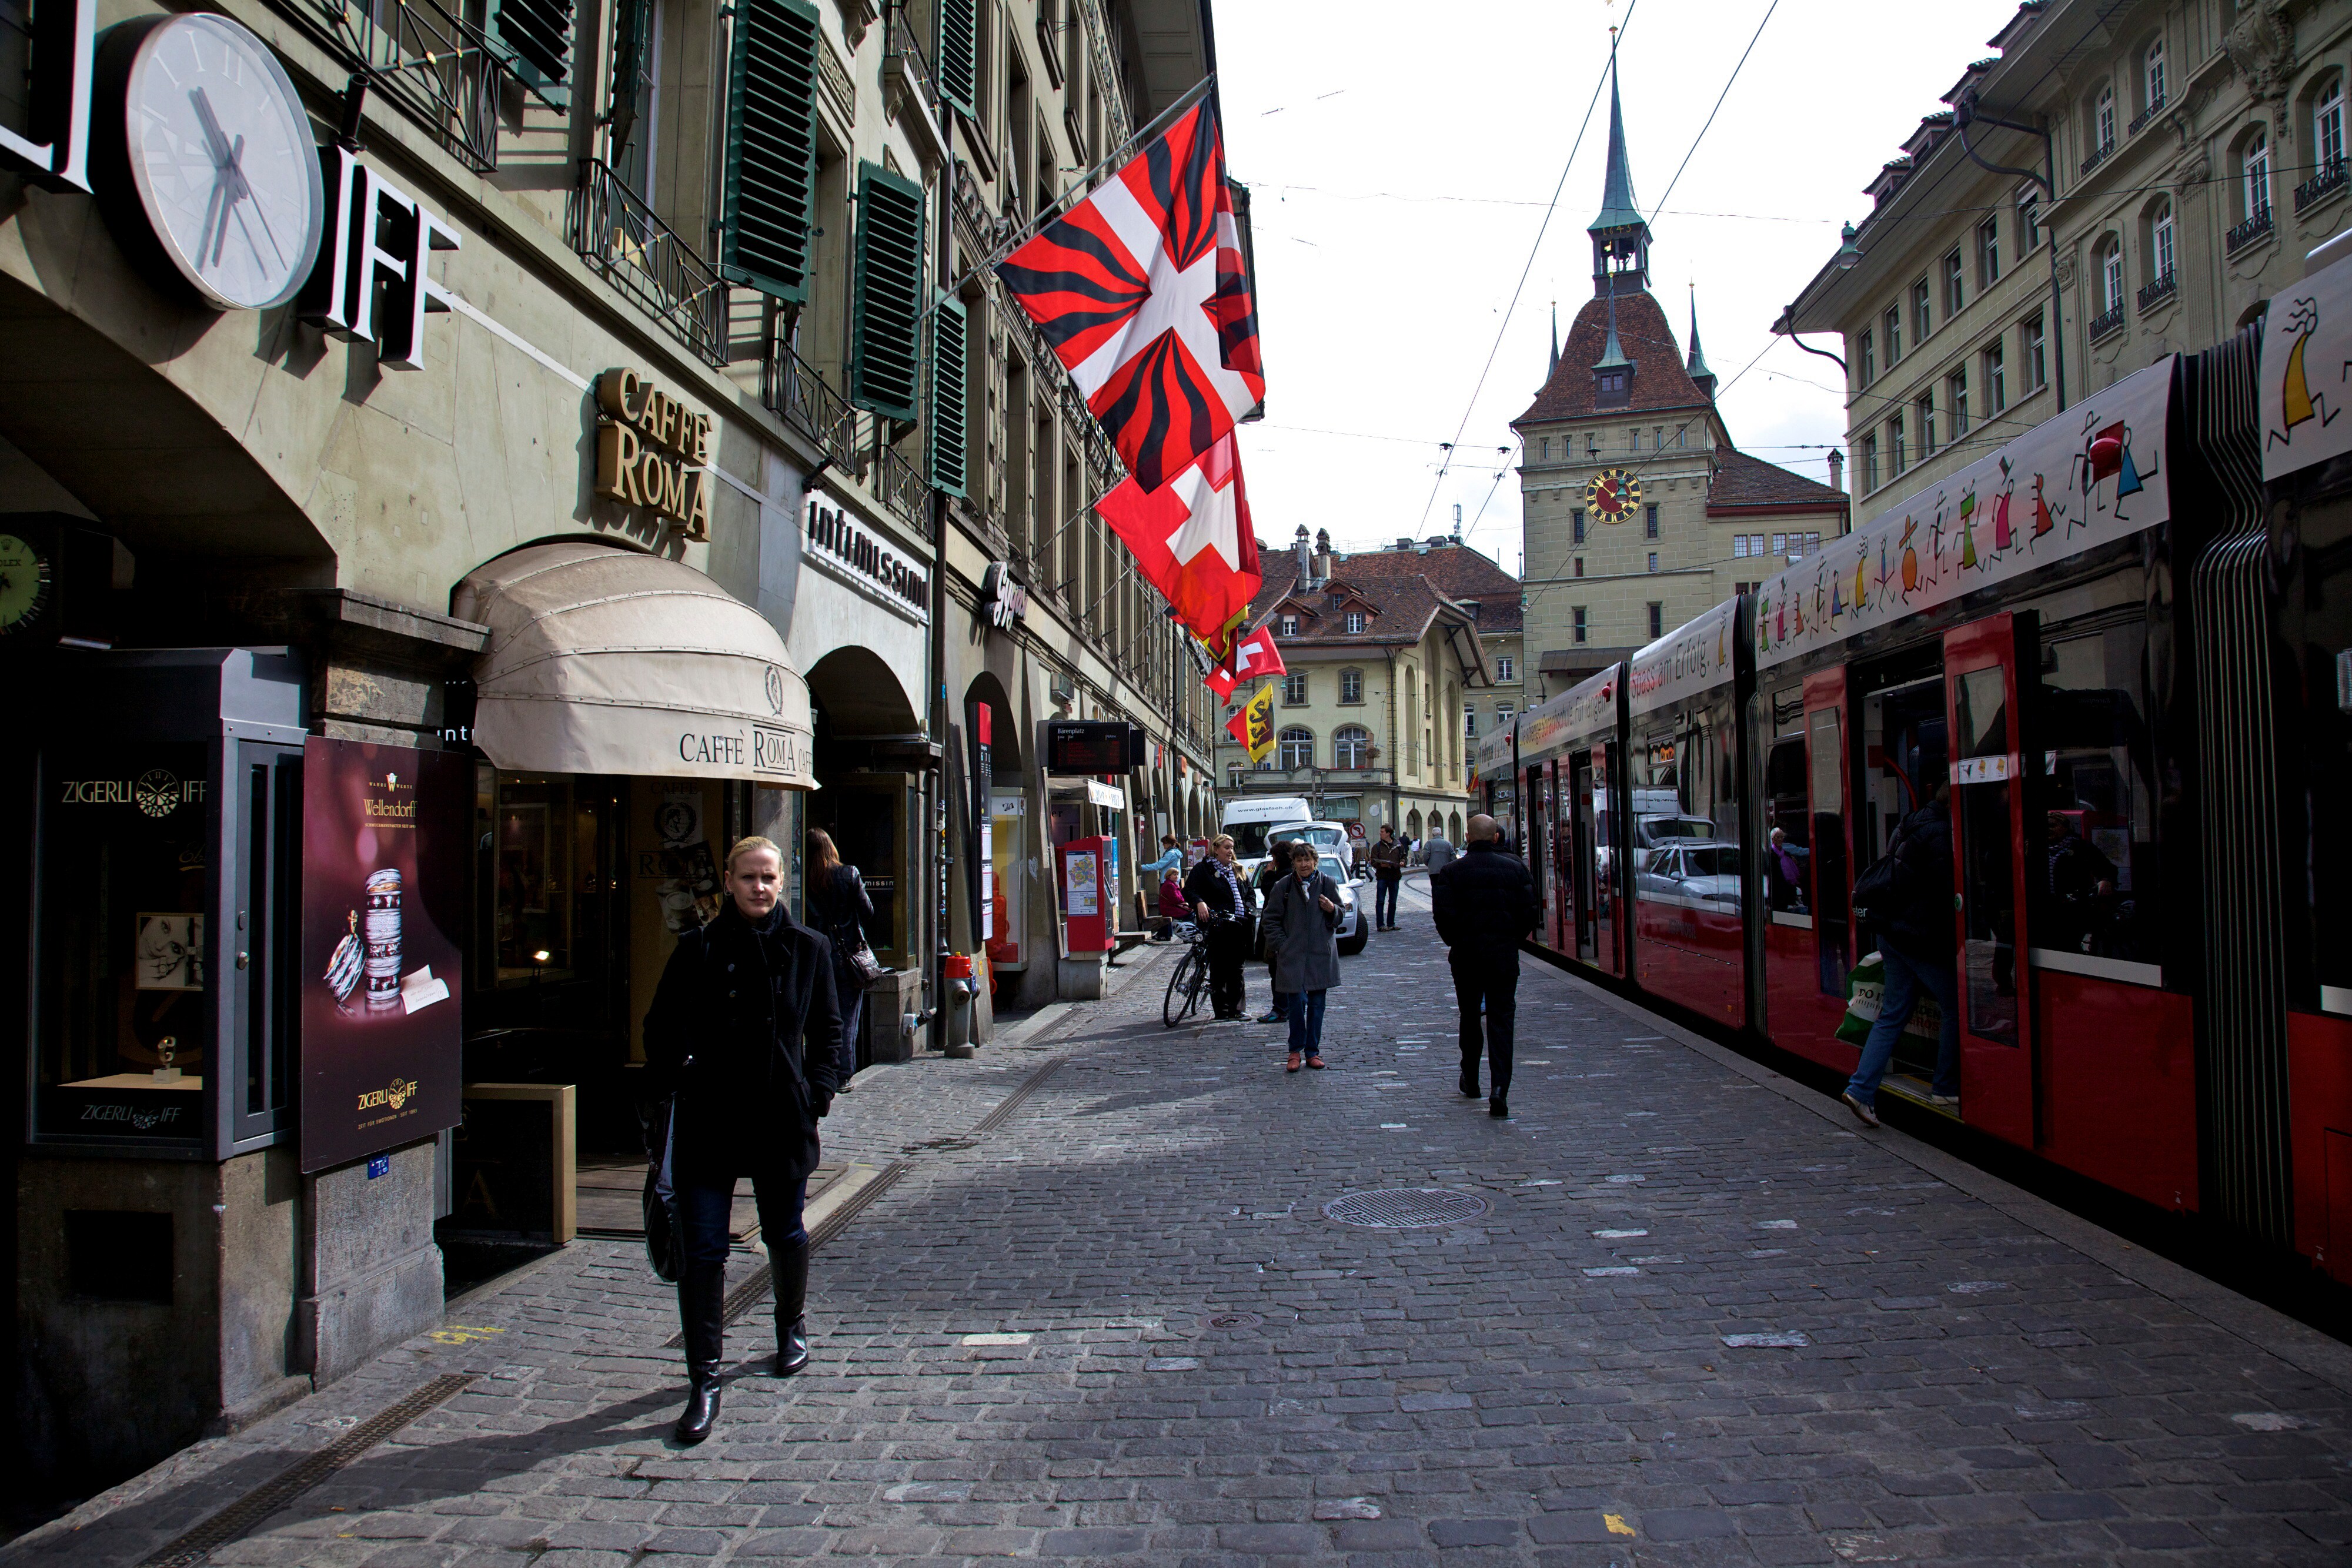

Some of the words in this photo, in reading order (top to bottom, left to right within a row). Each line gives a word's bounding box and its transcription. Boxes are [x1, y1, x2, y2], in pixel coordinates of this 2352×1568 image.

[328, 146, 462, 371] IFF
[619, 367, 713, 467] CAFFÈ
[612, 420, 711, 543] ROMA
[808, 501, 927, 610] intimissimi
[1632, 666, 1655, 704] Spass
[1659, 658, 1672, 687] am
[1676, 634, 1709, 680] Erfolg.
[680, 729, 744, 765] CAFFÈ
[753, 731, 797, 771] ROMA
[799, 748, 814, 774] CAFF
[61, 781, 132, 803] ZIGERLI
[182, 780, 208, 803] IFF
[363, 799, 418, 817] Wellendorff
[1859, 989, 1874, 999] DO
[81, 1104, 132, 1122] ZIGERLI
[159, 1105, 183, 1122] IFF
[358, 1088, 389, 1110] ZIGERLI
[406, 1081, 417, 1098] IFF
